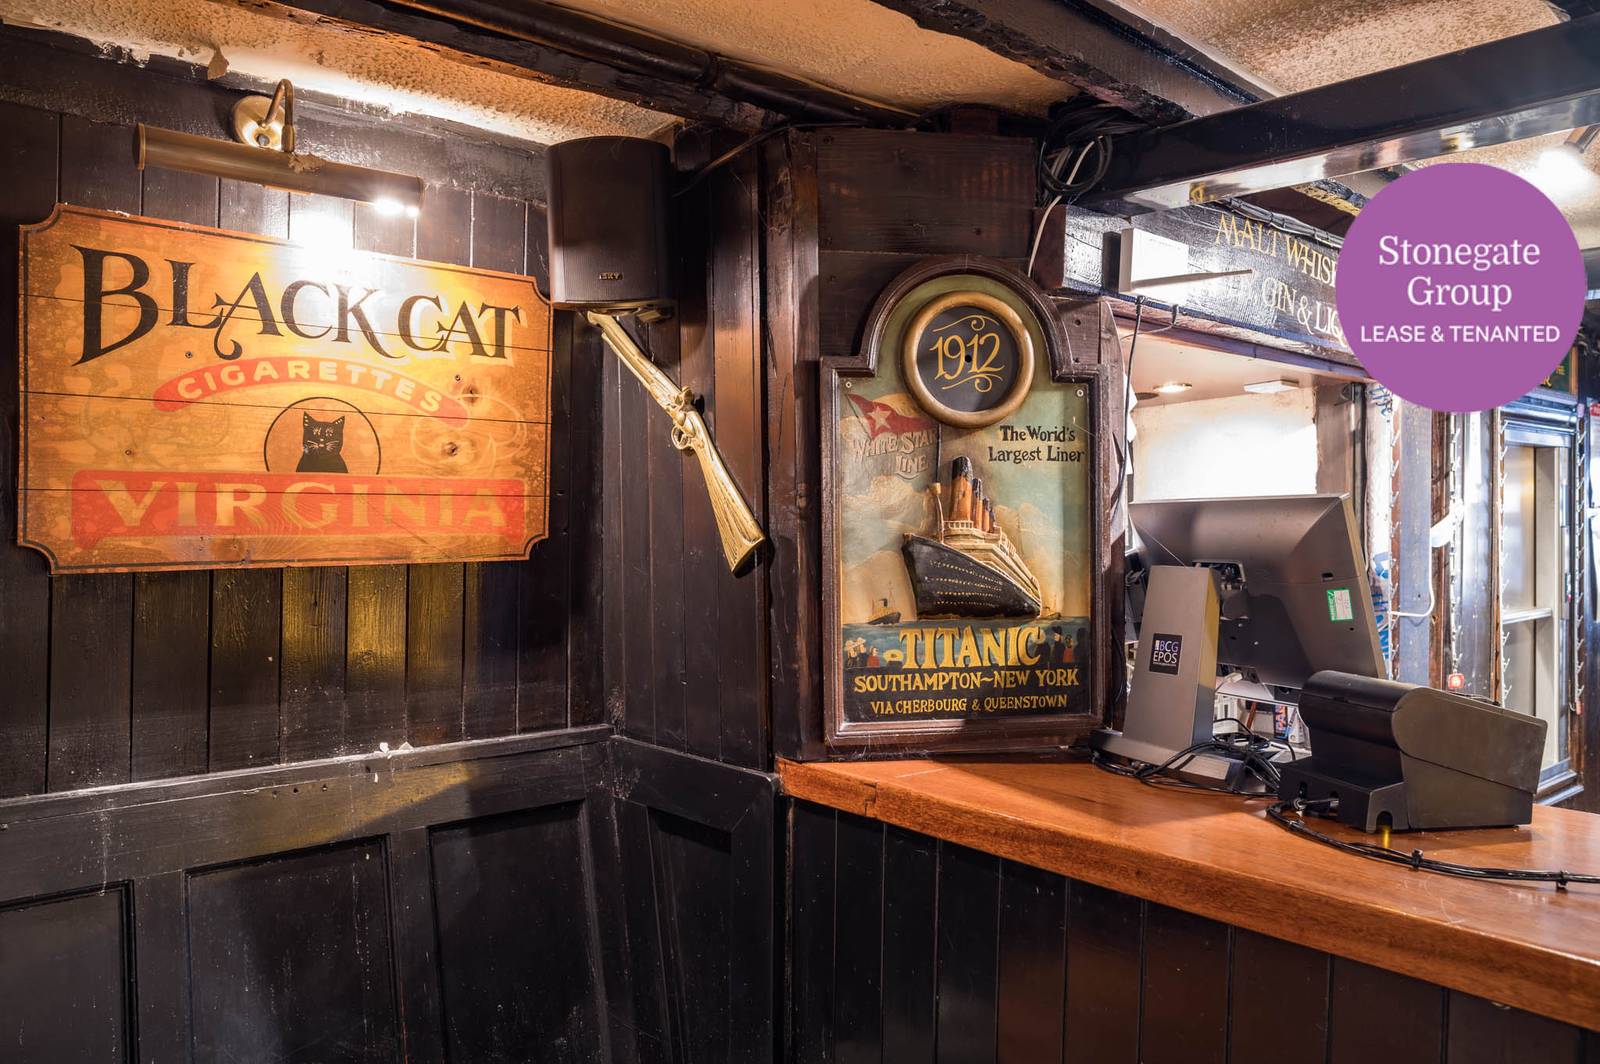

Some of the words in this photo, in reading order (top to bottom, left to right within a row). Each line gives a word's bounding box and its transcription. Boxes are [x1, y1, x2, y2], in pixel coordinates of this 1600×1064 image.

[1215, 212, 1282, 258] MALT
[69, 244, 406, 367] BLACK
[398, 295, 521, 360] CAT
[1261, 277, 1297, 316] GIN
[1297, 296, 1314, 335] &
[929, 332, 1005, 381] 1912
[178, 360, 443, 413] CIGARETTES
[1000, 425, 1026, 442] The
[853, 434, 898, 464] WHITE
[895, 453, 929, 474] LINE
[988, 446, 1042, 465] Largest
[1046, 445, 1085, 462] Liner
[95, 479, 507, 529] VIRGINIA
[899, 624, 1043, 669] TITANIC
[1153, 651, 1178, 664] EPOS
[1160, 640, 1179, 653] BCG
[1036, 668, 1080, 687] YORK
[871, 701, 895, 716] VIA
[896, 698, 967, 714] CHERBOURG
[971, 699, 981, 712] &
[983, 694, 1068, 713] QUEENSTOWN
